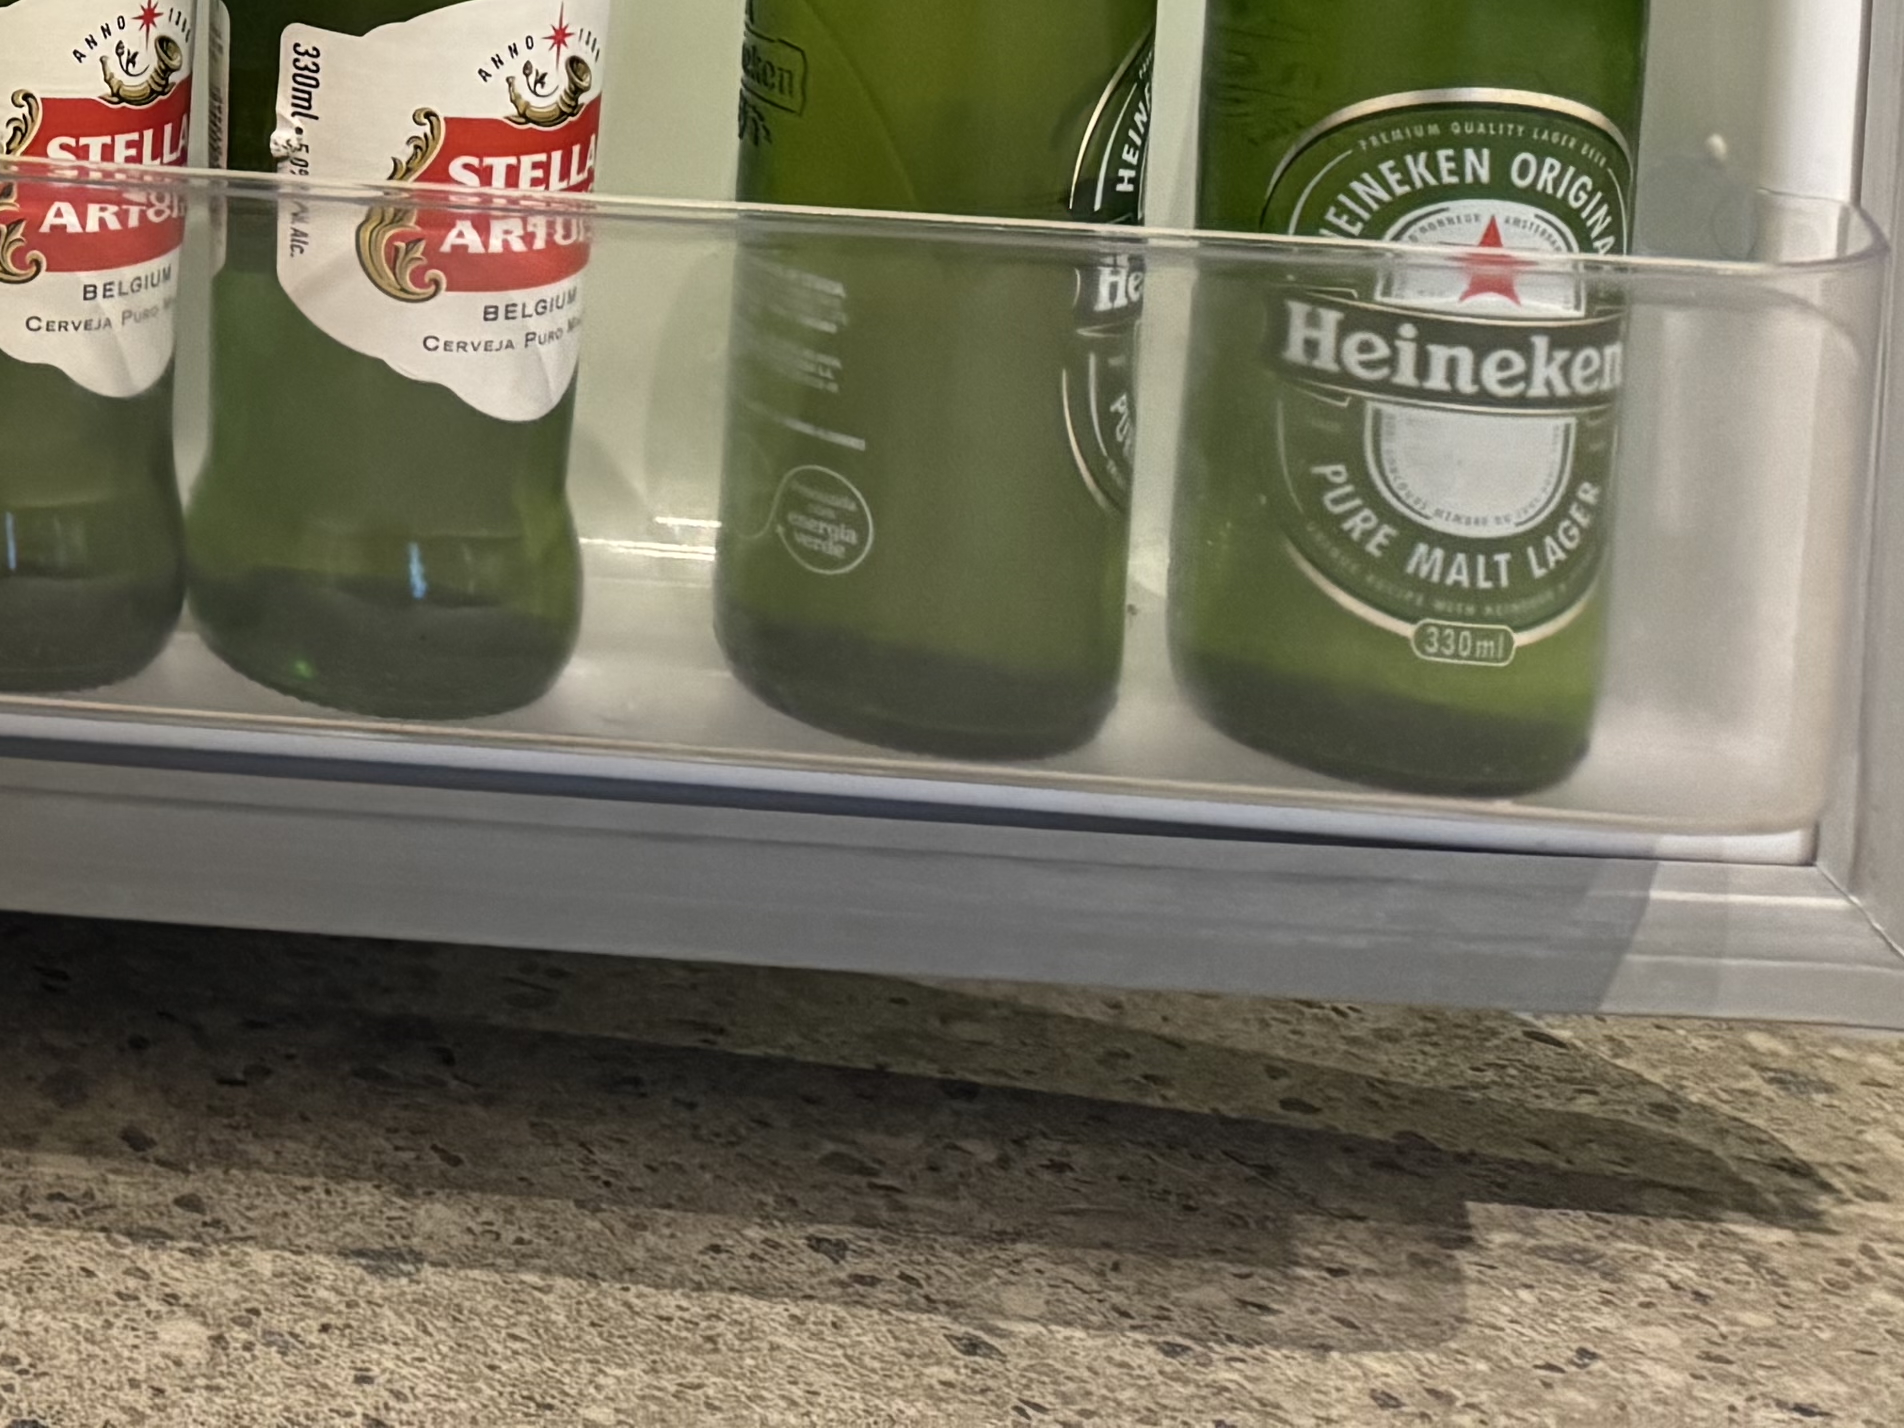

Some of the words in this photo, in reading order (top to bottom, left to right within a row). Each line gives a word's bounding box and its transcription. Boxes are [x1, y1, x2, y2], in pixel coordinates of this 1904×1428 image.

[73, 14, 127, 64] ANNO
[478, 34, 535, 83] ANNO
[291, 42, 321, 122] 330ml
[1358, 122, 1441, 151] PREMIUM
[1450, 120, 1525, 137] QUALITY
[1532, 127, 1576, 150] LAGER
[447, 133, 597, 191] STELLA
[1510, 151, 1616, 256] ORIGINA
[82, 265, 173, 302] BELGIUM
[482, 286, 578, 323] BELGIUM
[1282, 299, 1624, 398] Heineken
[1311, 463, 1401, 559] PURE
[1405, 541, 1513, 590] MALT
[1526, 480, 1602, 579] LAGER
[1424, 626, 1505, 660] 330ml
